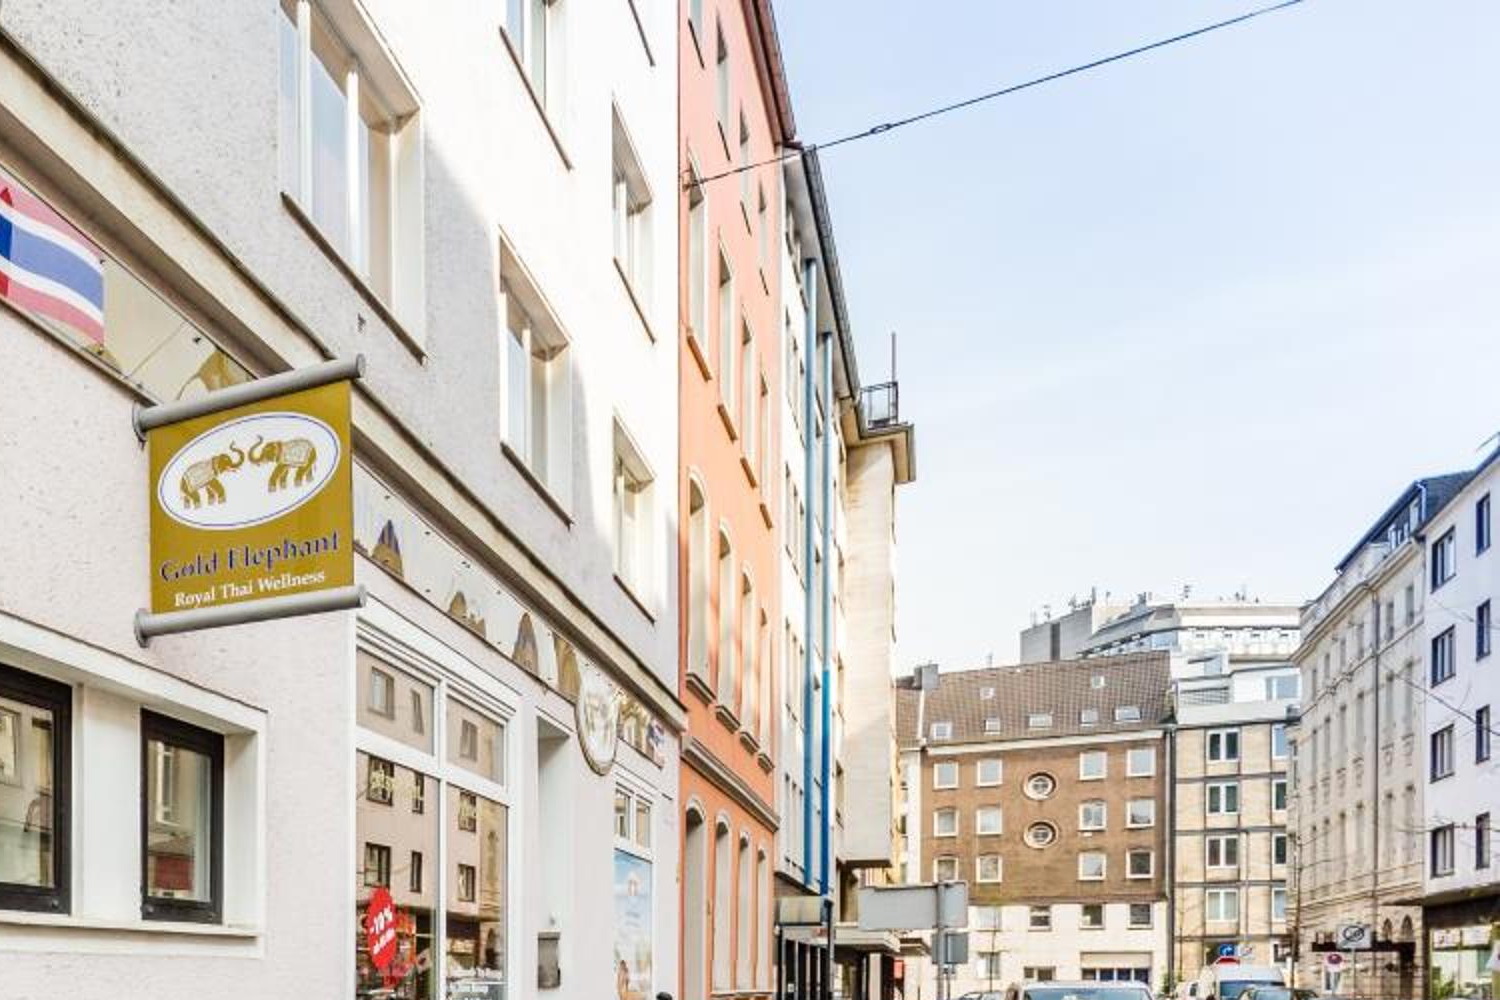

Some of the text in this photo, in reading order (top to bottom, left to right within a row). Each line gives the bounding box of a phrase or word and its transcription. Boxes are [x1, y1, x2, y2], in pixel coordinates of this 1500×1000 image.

[161, 530, 340, 582] Gold Elephant
[174, 569, 326, 608] Royal Thai Wellness
